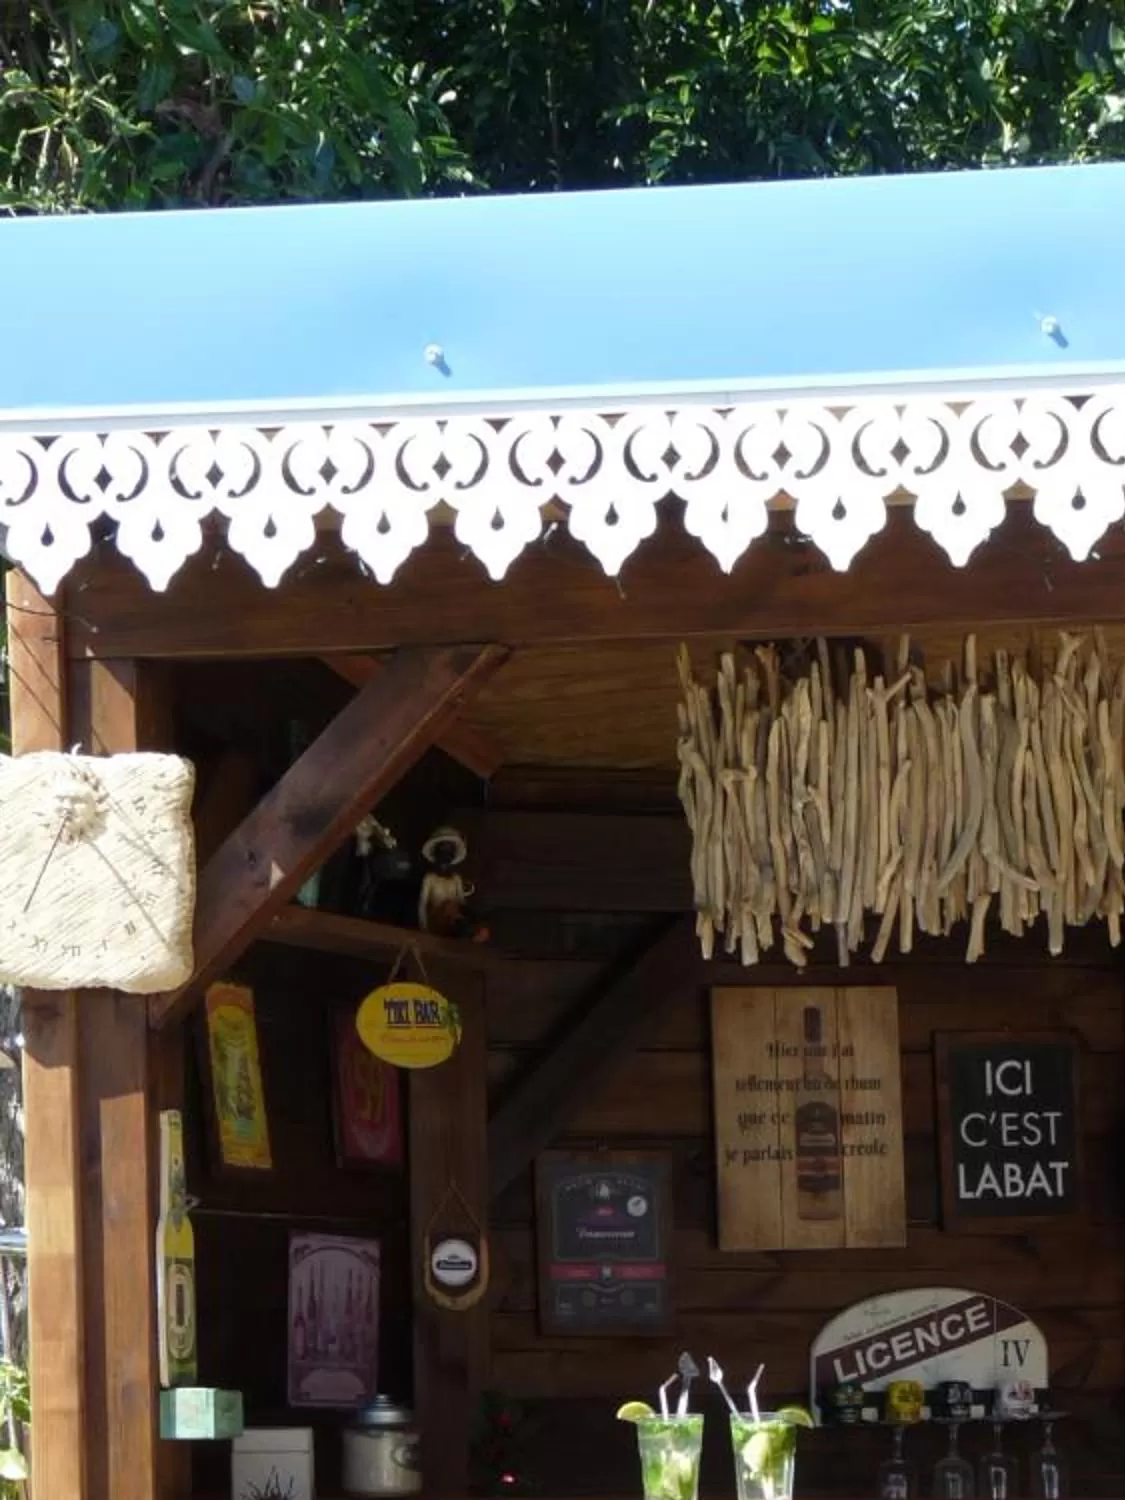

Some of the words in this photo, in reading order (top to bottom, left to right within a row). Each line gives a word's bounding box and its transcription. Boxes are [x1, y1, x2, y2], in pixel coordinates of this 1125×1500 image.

[985, 1059, 1033, 1096] ICI
[960, 1111, 1063, 1147] C'EST
[958, 1161, 1069, 1199] LABAT
[833, 1303, 991, 1384] LICENCE
[1001, 1338, 1031, 1367] IV
